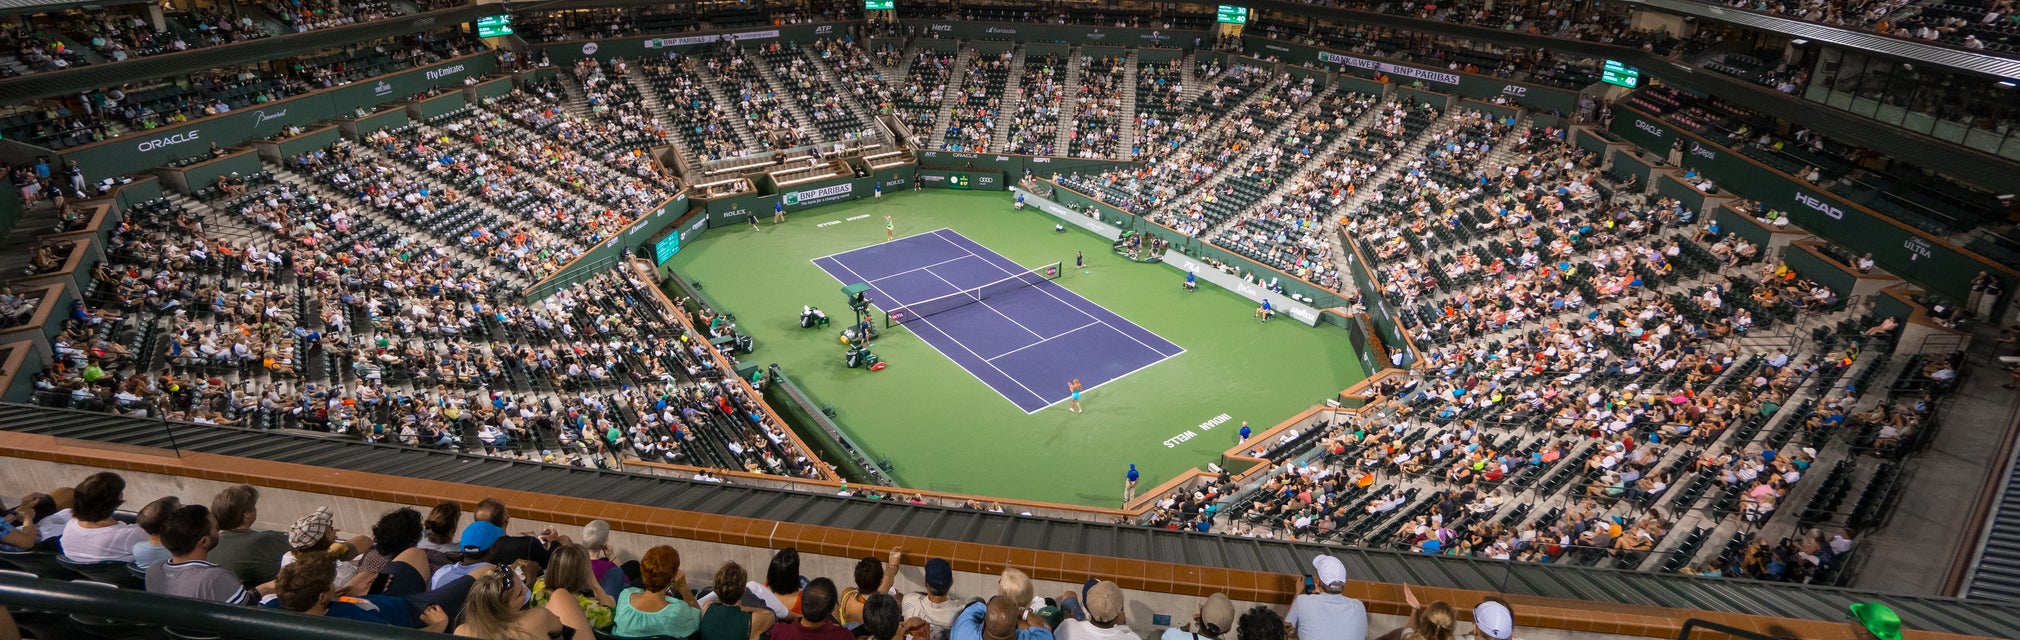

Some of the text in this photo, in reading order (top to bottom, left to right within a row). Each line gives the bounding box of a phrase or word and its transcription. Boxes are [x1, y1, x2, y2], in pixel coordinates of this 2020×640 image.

[816, 25, 832, 33] ATP
[679, 37, 705, 45] PARIBAS
[1329, 54, 1352, 66] BANK
[426, 64, 465, 80] Fly Emirates
[1393, 65, 1457, 84] BNP PARIBAS
[1625, 76, 1636, 85] 40
[1502, 84, 1527, 94] ATP
[1635, 119, 1664, 137] ORACLE
[138, 129, 199, 152] ORACLE
[887, 178, 905, 187] ROLEX
[800, 184, 850, 200] BNP PARIBAS
[723, 208, 746, 218] ROLEX
[1794, 191, 1844, 221] HEAD
[1903, 239, 1931, 259] ULTRA
[1183, 260, 1200, 273] FILA
[1163, 413, 1232, 448] INDIAN WELLS
